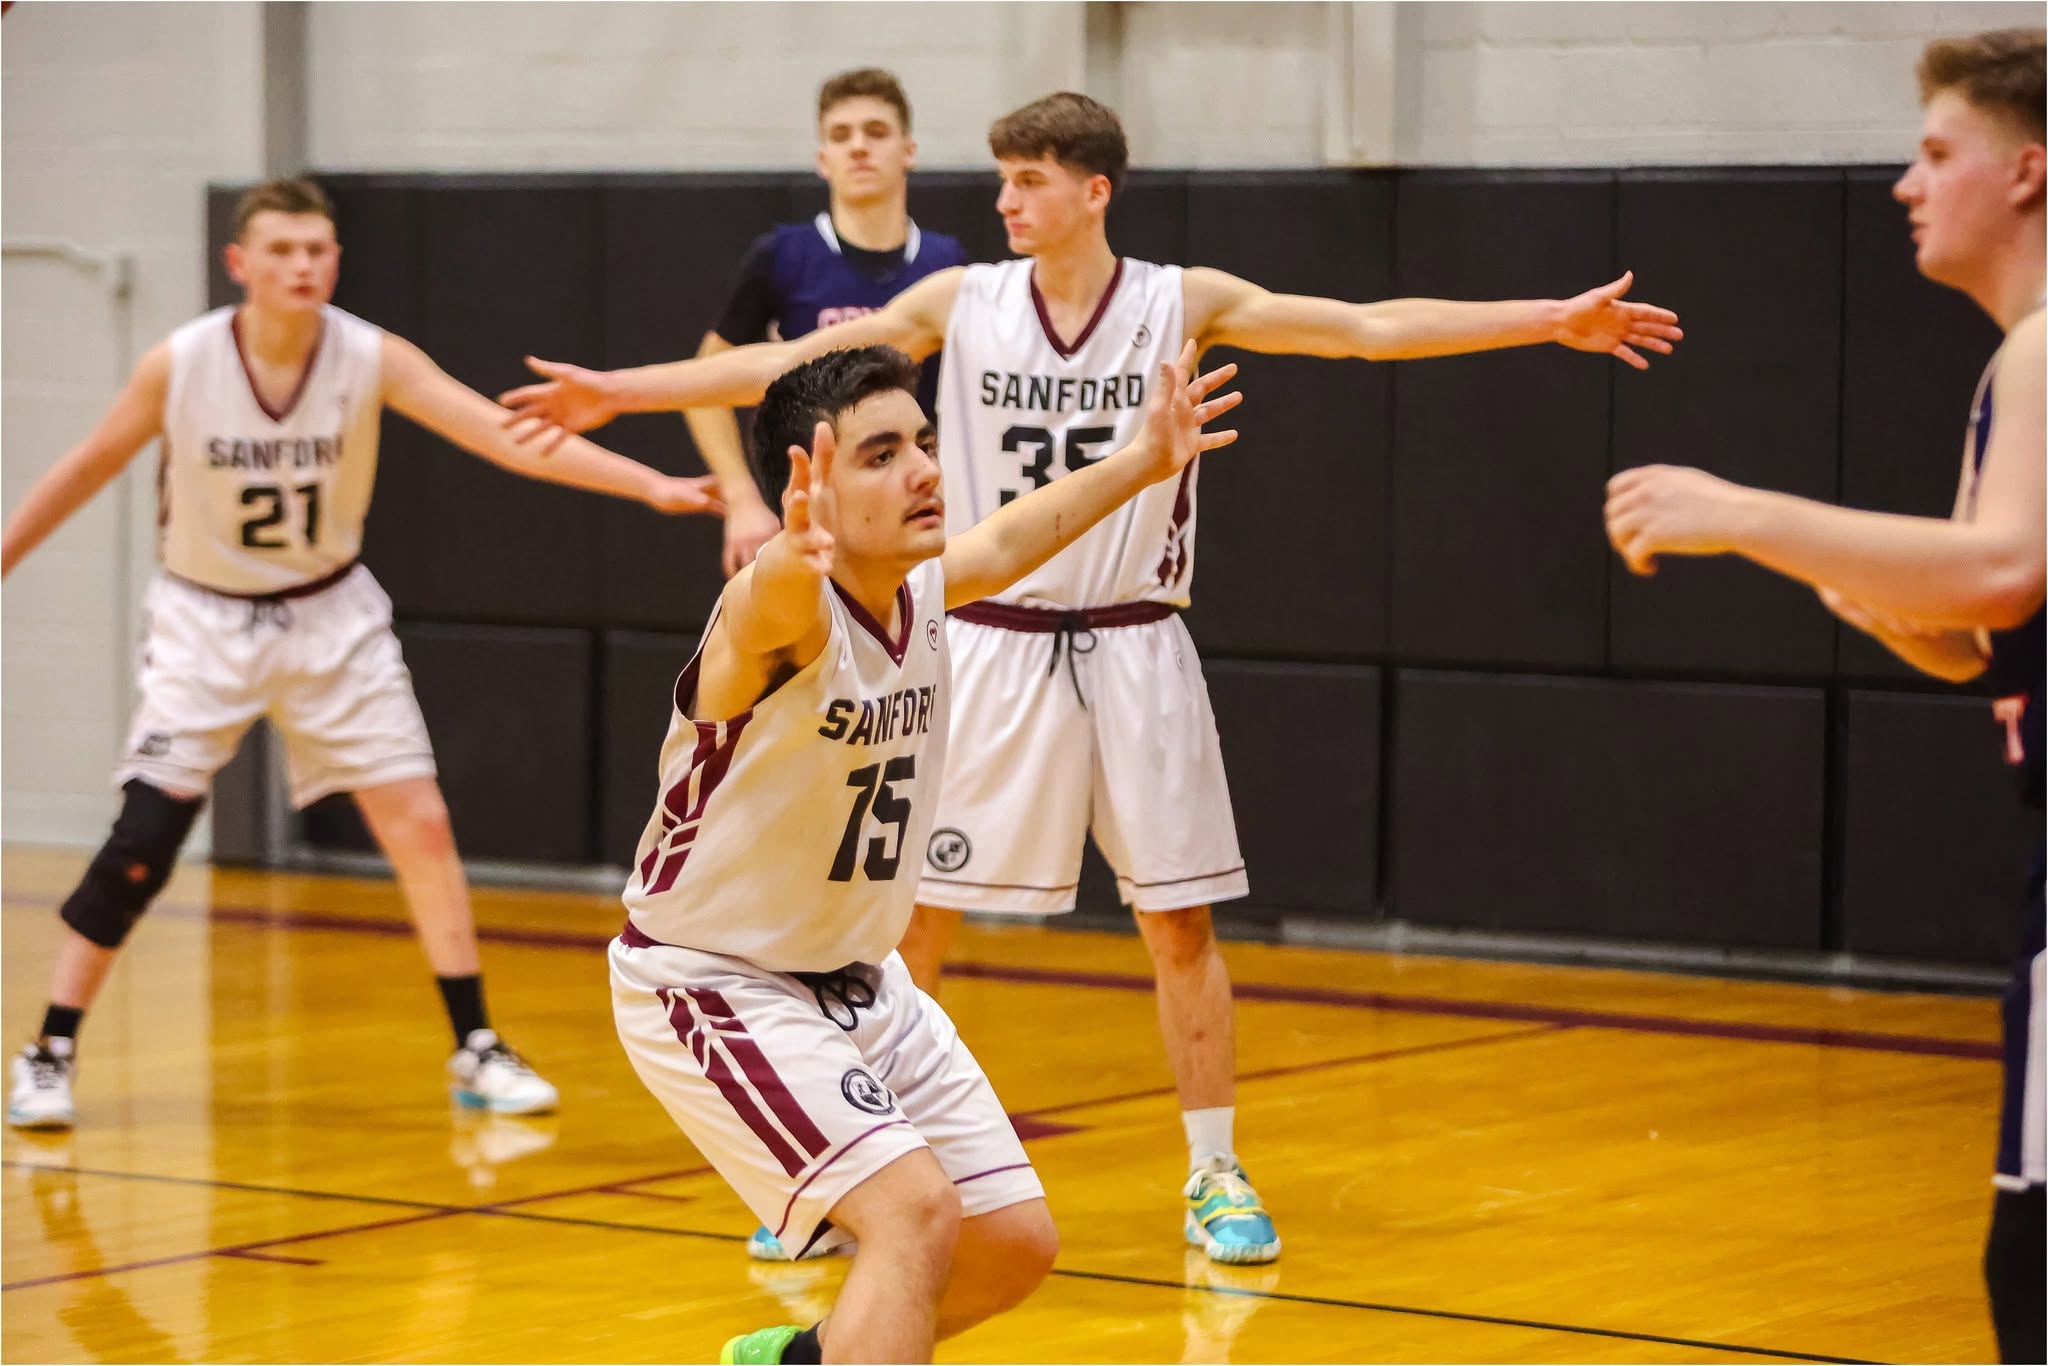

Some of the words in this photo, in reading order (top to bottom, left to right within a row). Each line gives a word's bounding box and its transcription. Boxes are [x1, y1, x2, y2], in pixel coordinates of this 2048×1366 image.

[981, 370, 1145, 411] SANFORD
[207, 436, 344, 469] SANFOR
[240, 484, 319, 548] 21
[817, 685, 937, 746] SANFOR
[827, 754, 915, 881] 15
